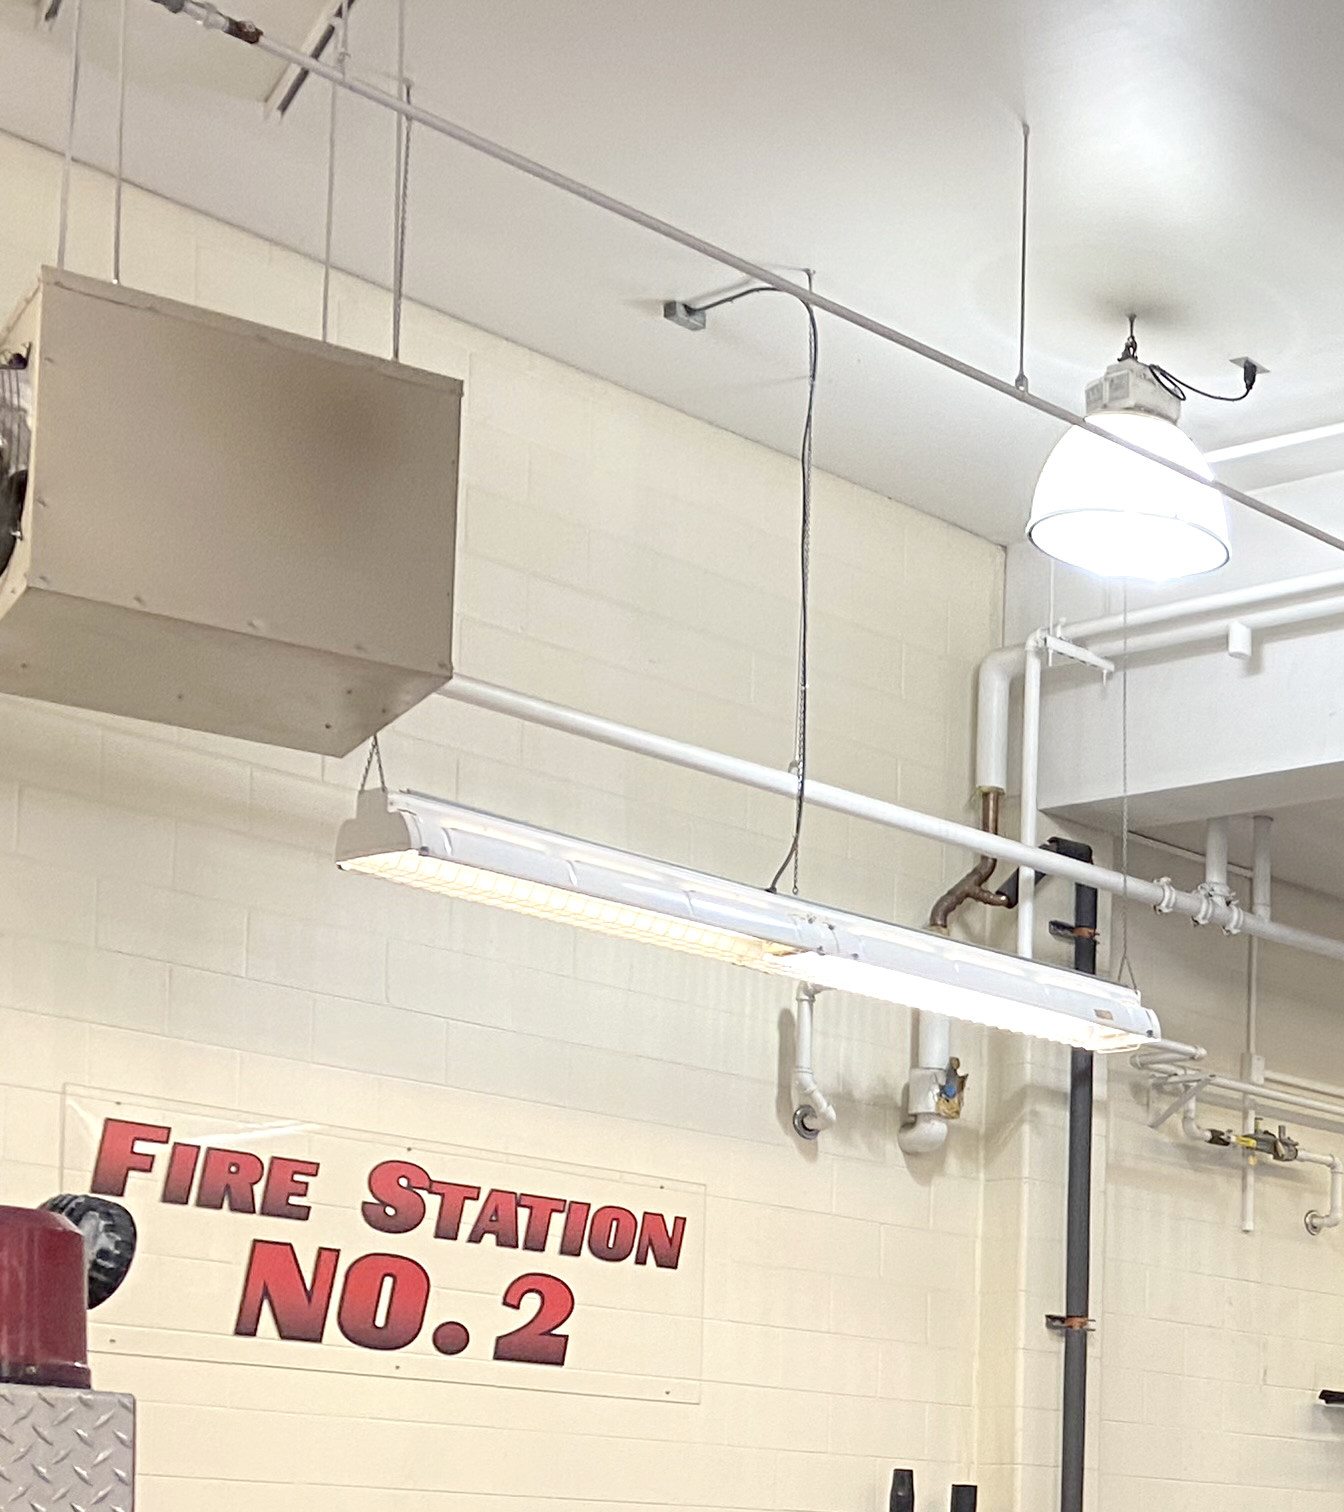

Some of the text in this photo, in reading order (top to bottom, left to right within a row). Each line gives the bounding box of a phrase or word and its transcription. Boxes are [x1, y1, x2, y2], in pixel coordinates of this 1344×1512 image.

[91, 1117, 687, 1270] FIRE STATION
[233, 1239, 576, 1367] NO. 2
